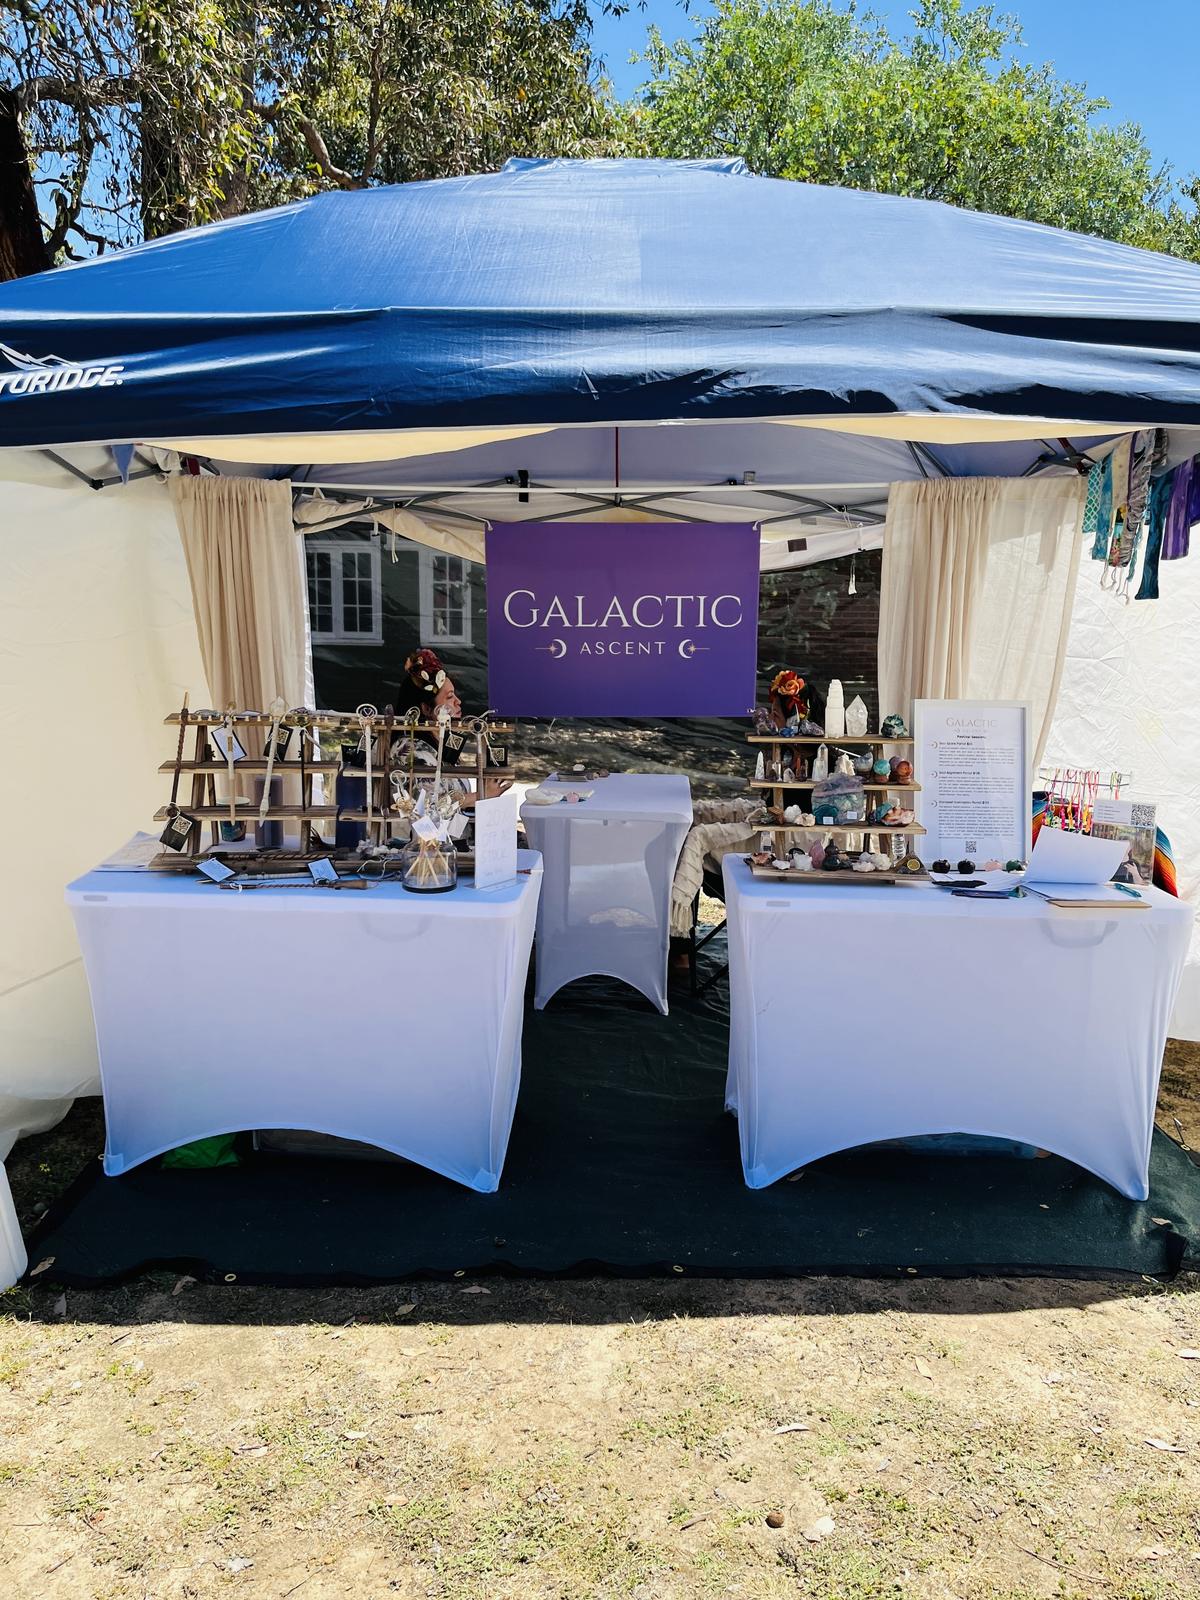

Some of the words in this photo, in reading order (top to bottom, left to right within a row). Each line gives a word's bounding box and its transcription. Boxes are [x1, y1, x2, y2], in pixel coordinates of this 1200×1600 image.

[504, 589, 743, 628] GALACTIC
[580, 641, 666, 655] ASCENT
[946, 717, 996, 728] GALACTIC
